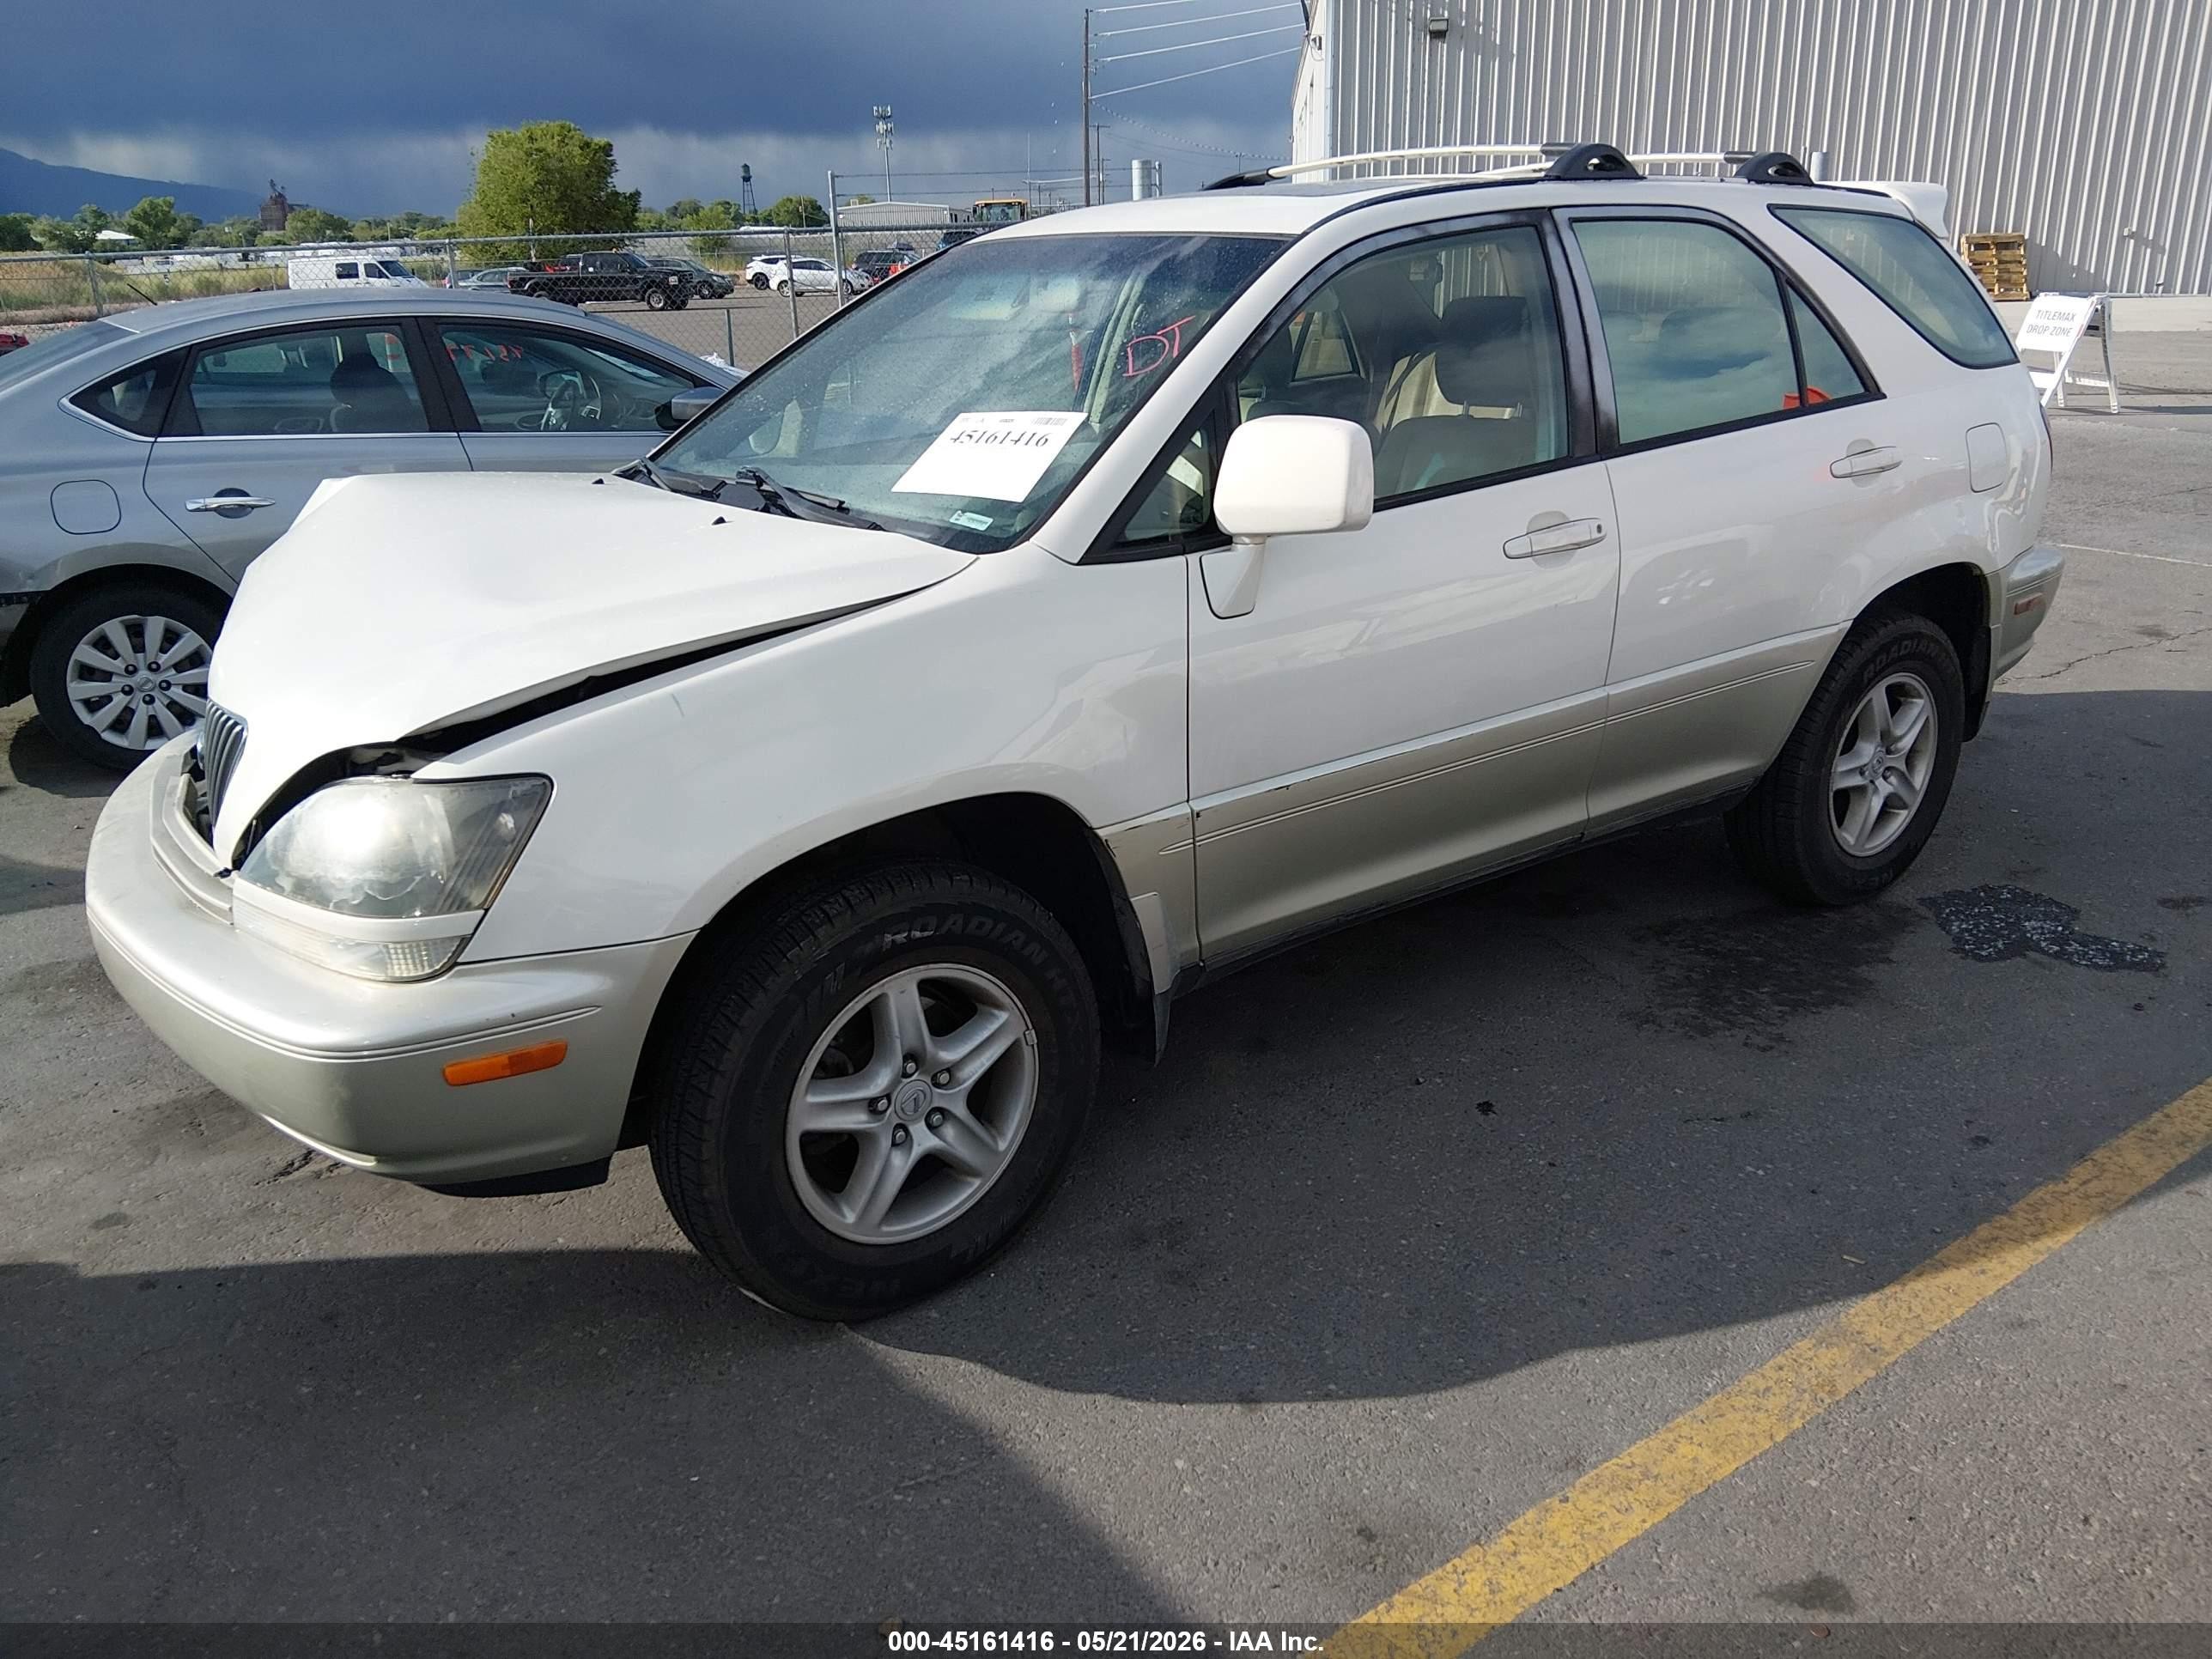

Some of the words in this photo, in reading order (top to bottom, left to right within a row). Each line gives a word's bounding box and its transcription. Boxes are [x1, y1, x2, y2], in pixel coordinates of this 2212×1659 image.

[2036, 310, 2076, 322] TITLEMAX
[2027, 325, 2050, 334] DROP
[2050, 325, 2074, 337] ZONE
[1122, 315, 1196, 377] DT
[950, 429, 1053, 447] 45161416
[881, 912, 1050, 967] ROADIAN
